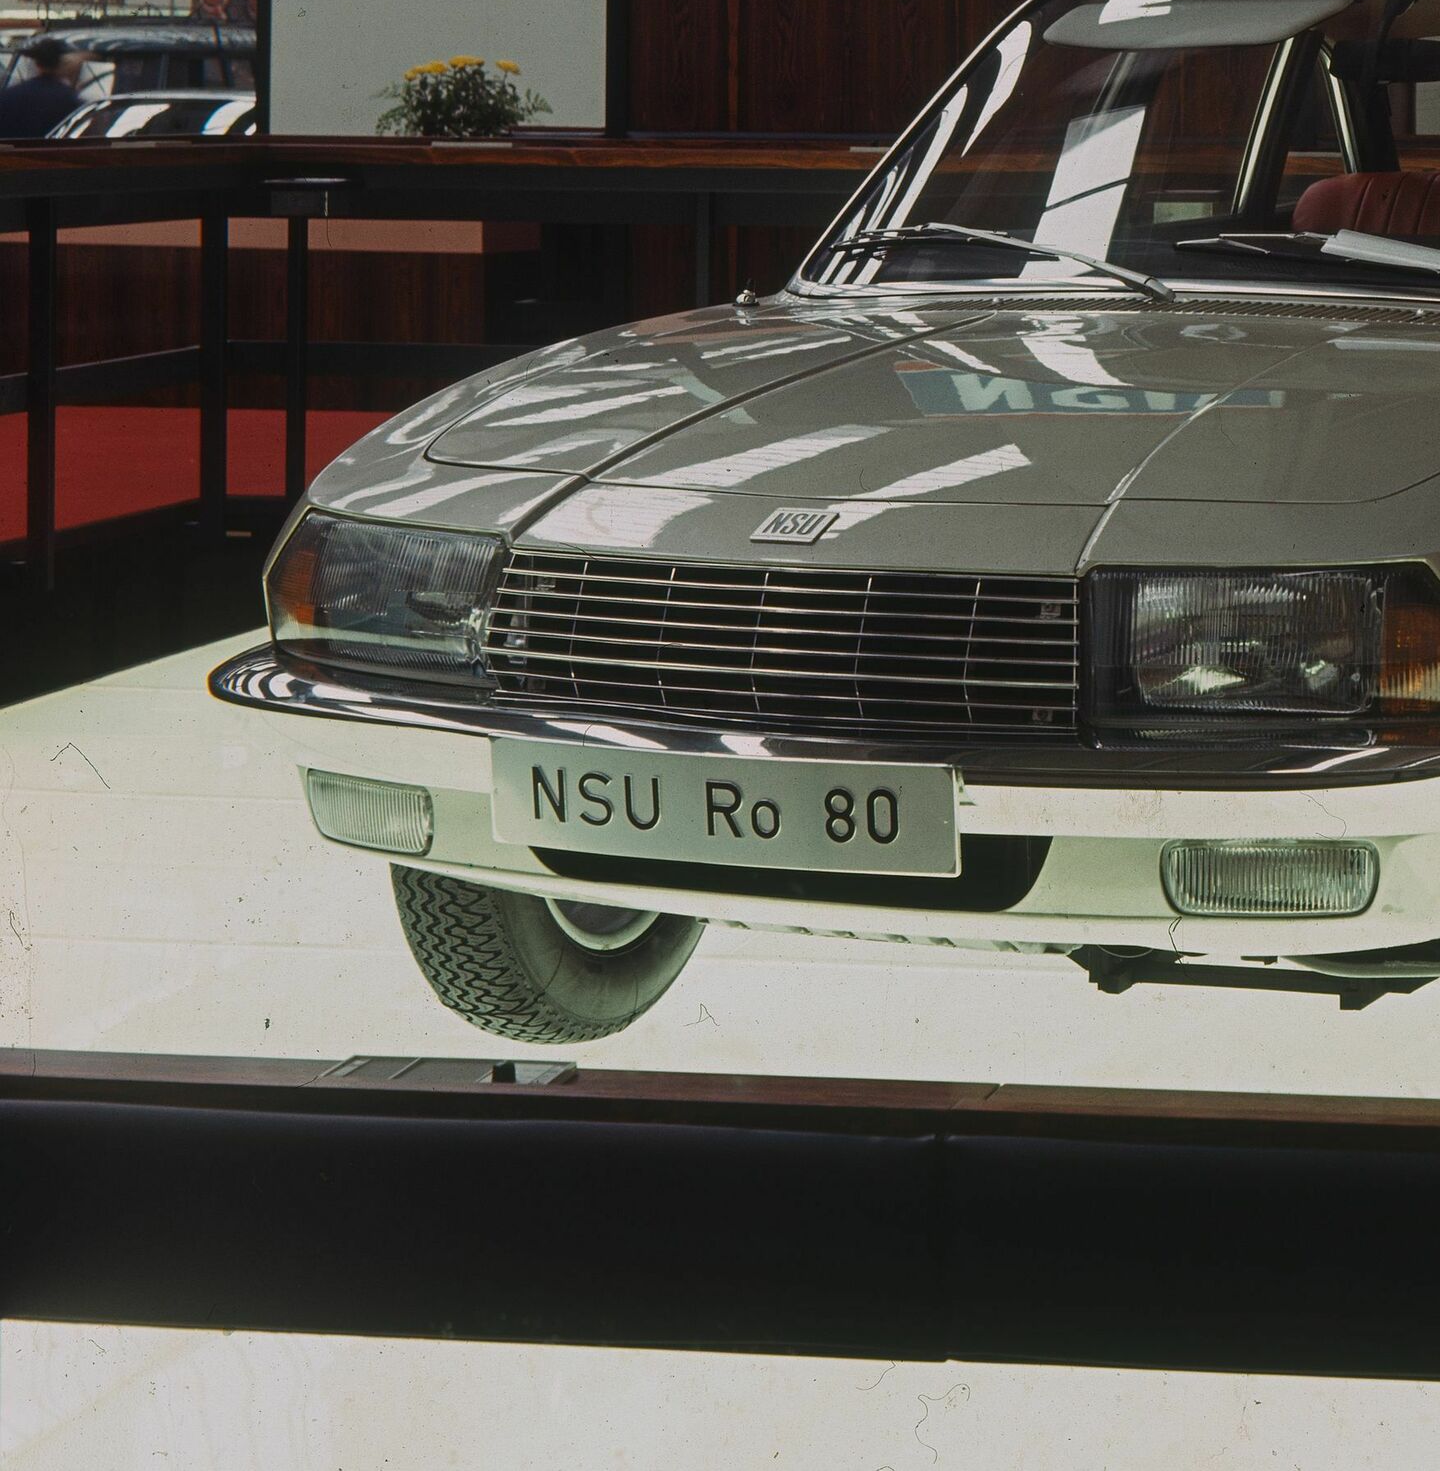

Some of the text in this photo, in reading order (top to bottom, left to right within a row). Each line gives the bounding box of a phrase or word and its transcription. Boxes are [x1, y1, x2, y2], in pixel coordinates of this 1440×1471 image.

[762, 512, 827, 535] NSU
[531, 764, 900, 845] NSU Ro 80
